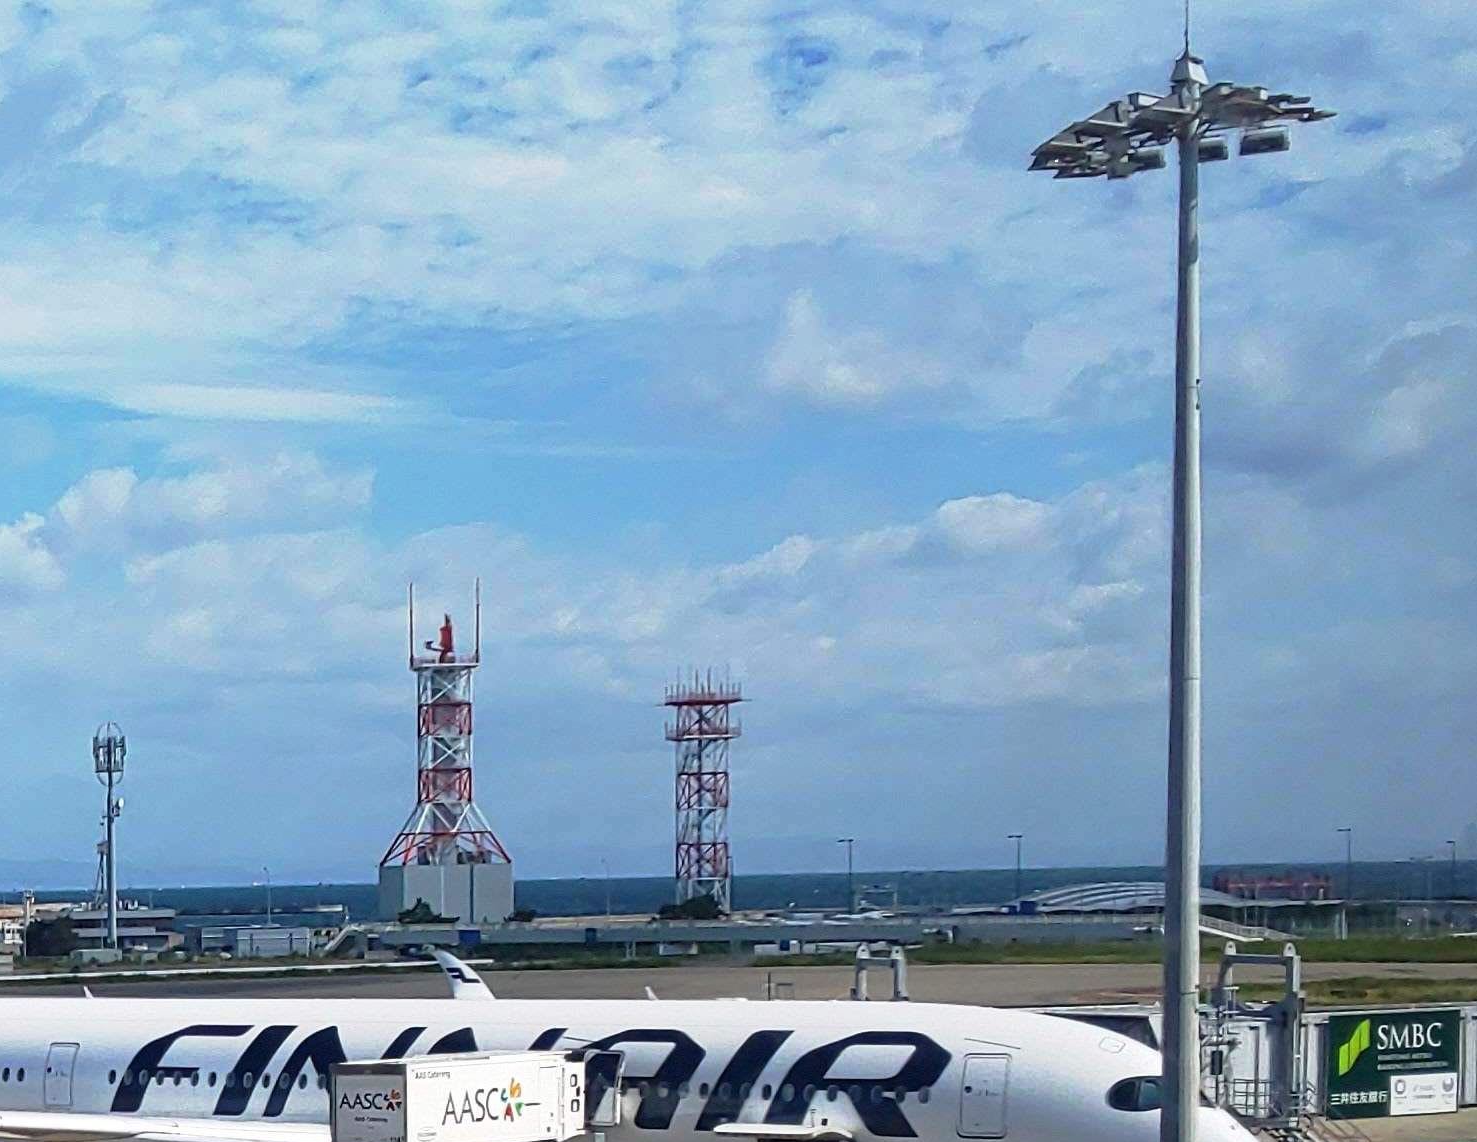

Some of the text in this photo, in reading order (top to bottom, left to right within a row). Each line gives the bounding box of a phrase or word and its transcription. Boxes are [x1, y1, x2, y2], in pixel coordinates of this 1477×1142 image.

[1377, 1022, 1443, 1050] SMBC
[340, 1092, 383, 1110] AASC
[442, 1086, 500, 1126] AASC
